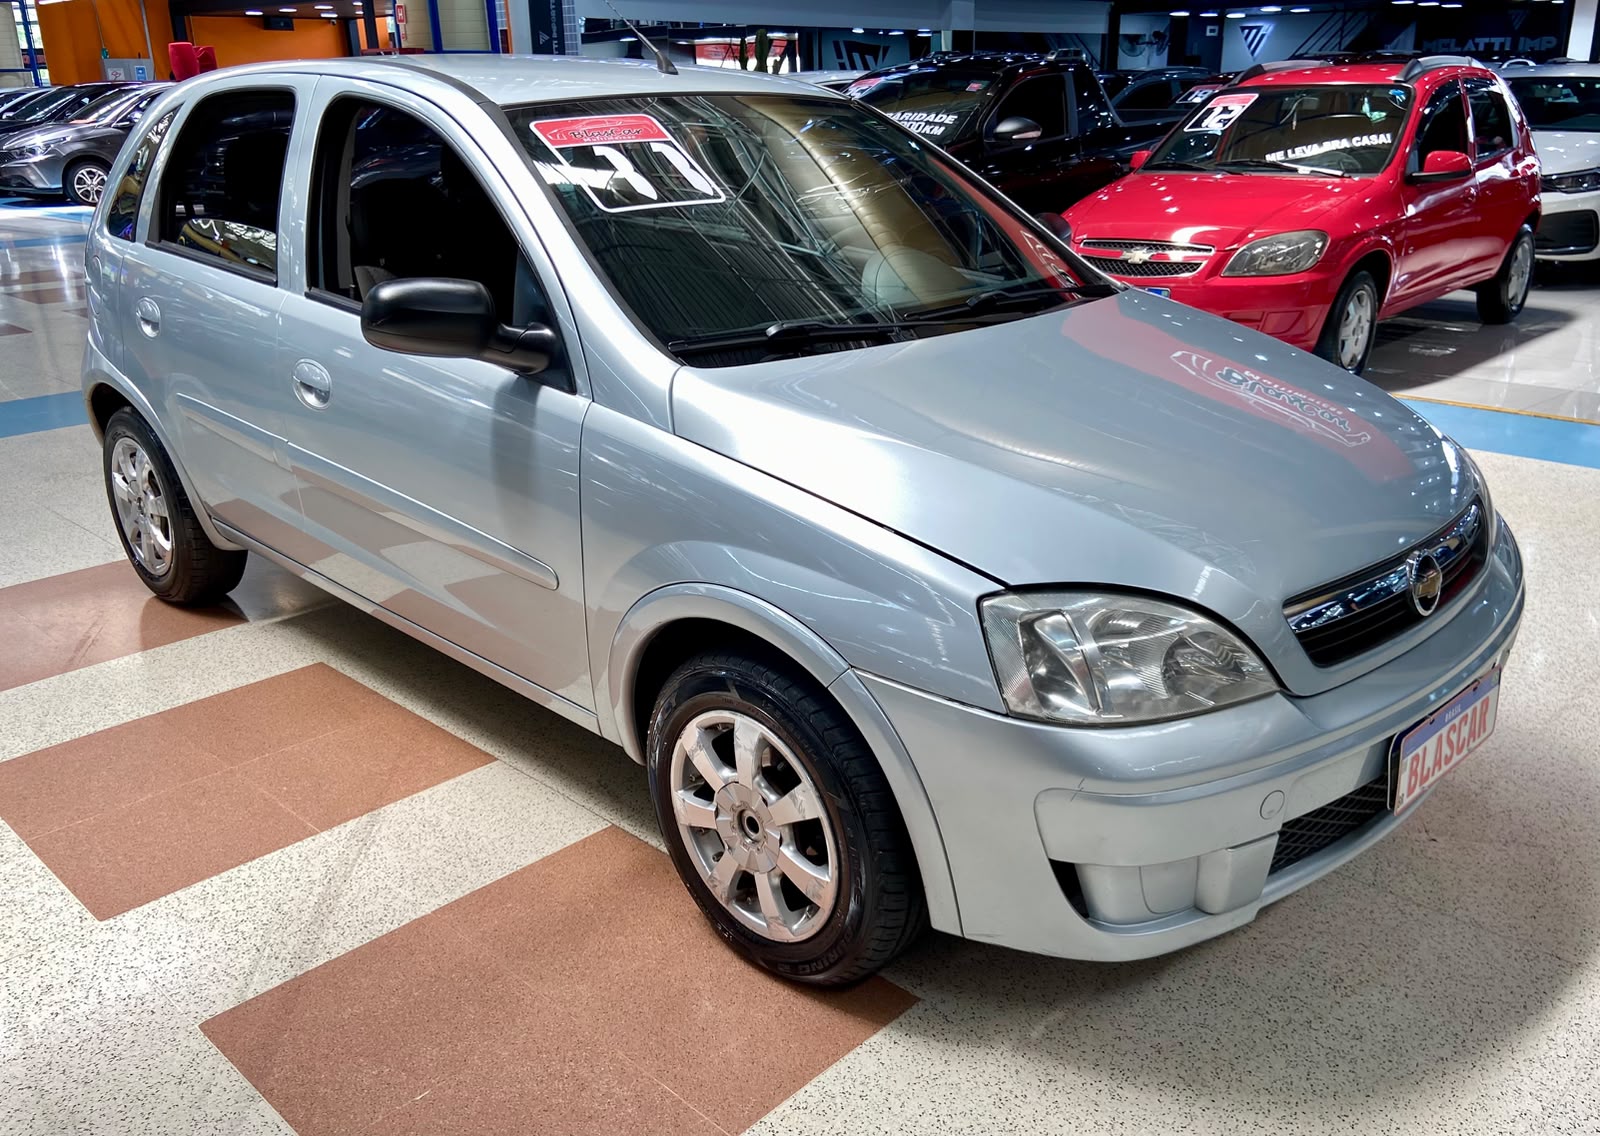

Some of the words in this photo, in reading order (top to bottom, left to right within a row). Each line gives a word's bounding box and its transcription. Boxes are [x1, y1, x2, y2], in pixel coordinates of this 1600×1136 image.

[1201, 104, 1243, 128] 12
[1265, 150, 1285, 162] ME
[1352, 133, 1392, 147] CASA!
[1407, 695, 1490, 799] BLASCAR
